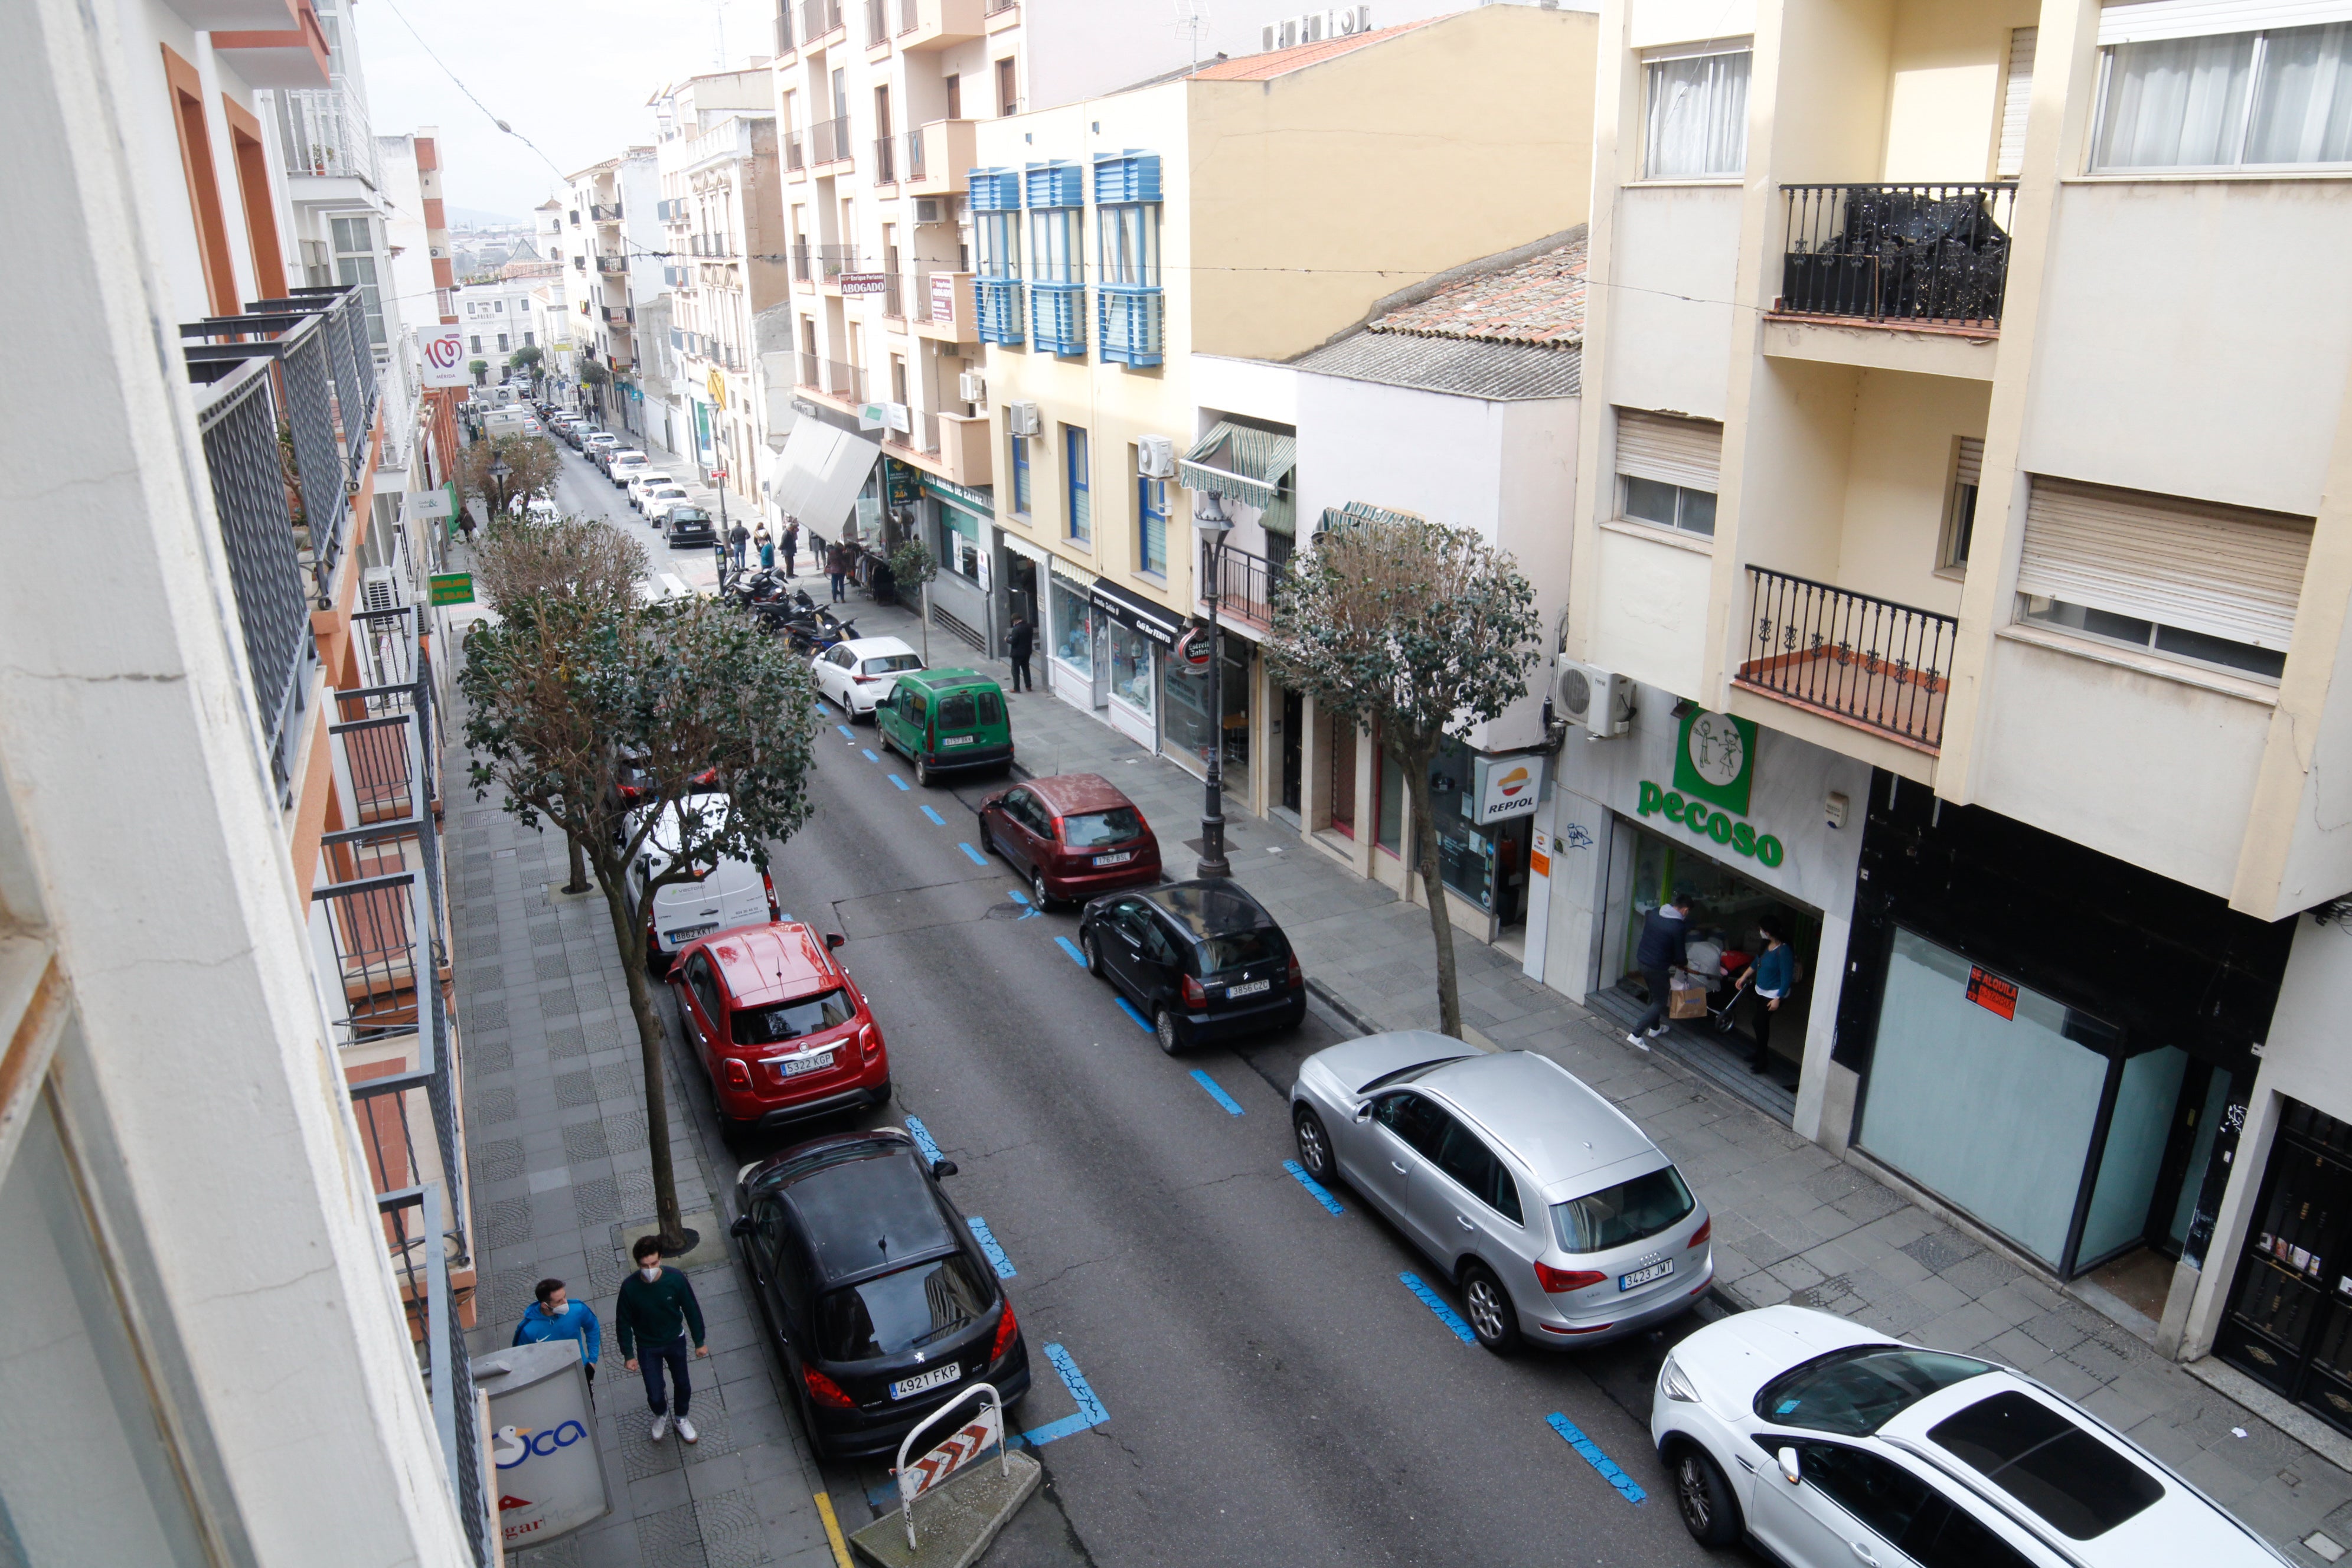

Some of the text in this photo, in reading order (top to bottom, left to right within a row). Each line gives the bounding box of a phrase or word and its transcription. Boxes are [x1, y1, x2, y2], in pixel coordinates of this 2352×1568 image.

[842, 282, 884, 293] ABOGADO
[933, 288, 951, 298] ABOGADO
[936, 476, 954, 494] RURAL
[955, 483, 963, 497] DE
[1136, 620, 1145, 631] Café
[1145, 625, 1154, 635] Bar
[1188, 641, 1209, 651] Estrell
[1190, 647, 1209, 657] Galici
[1488, 797, 1533, 814] REPSOL
[1637, 780, 1783, 867] pecoso
[1099, 853, 1128, 864] 1767 BSL
[678, 884, 705, 893] vectalia
[676, 931, 695, 940] 8862
[1233, 981, 1268, 995] 3856 CZC
[1971, 967, 2017, 999] SE ALQUILA
[787, 1059, 811, 1072] 5322
[813, 1054, 831, 1066] KGP
[1626, 1260, 1671, 1286] 3423 JMT
[900, 1365, 956, 1393] 4921 FKP
[501, 1518, 543, 1541] gar
